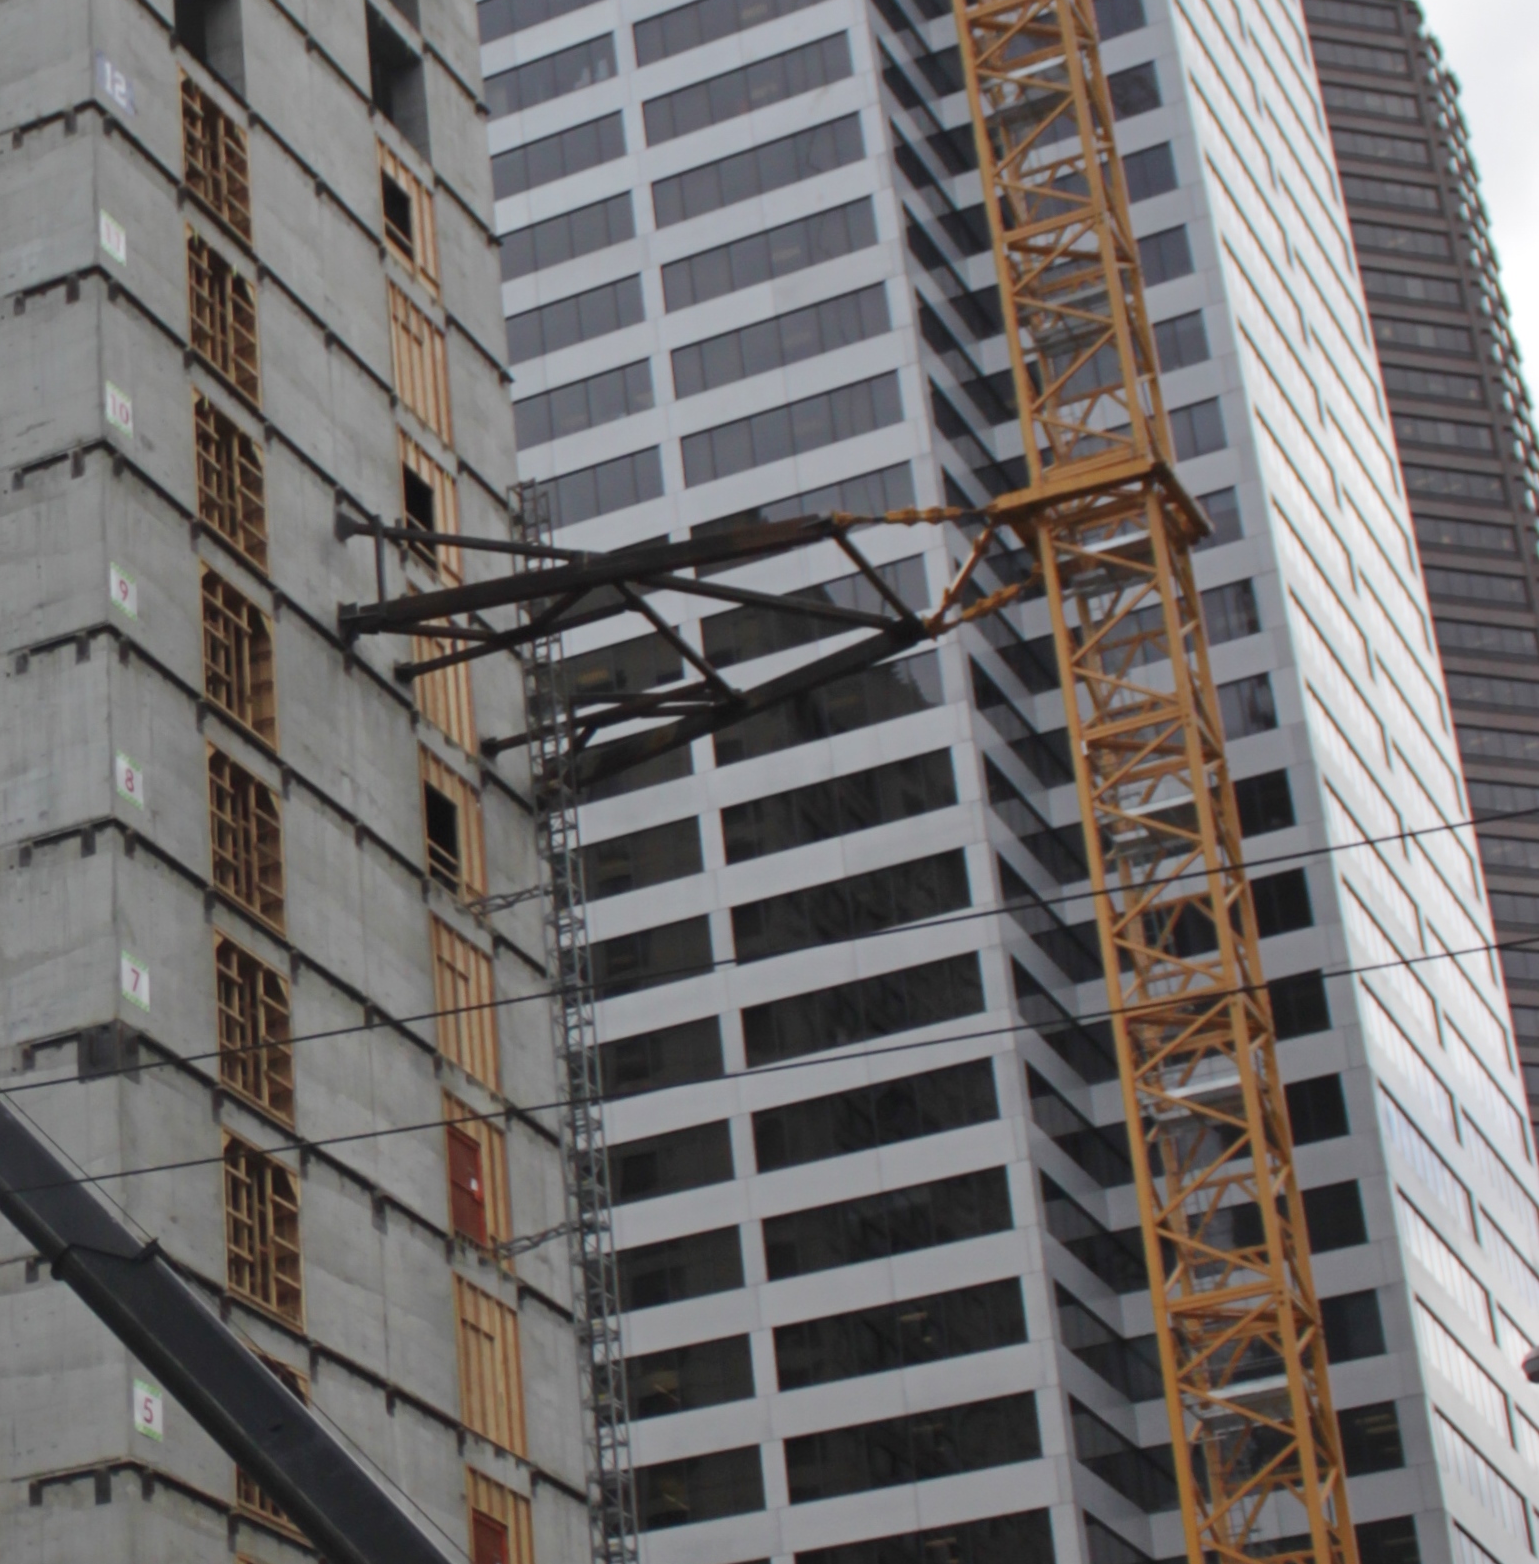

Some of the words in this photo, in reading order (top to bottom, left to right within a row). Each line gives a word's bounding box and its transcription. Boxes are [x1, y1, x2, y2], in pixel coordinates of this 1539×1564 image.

[104, 62, 127, 107] 12
[105, 222, 121, 252] 11
[111, 392, 129, 425] 10
[119, 578, 129, 602] 9
[125, 768, 134, 793] 8
[131, 967, 140, 991] 7
[143, 1396, 153, 1424] 5
